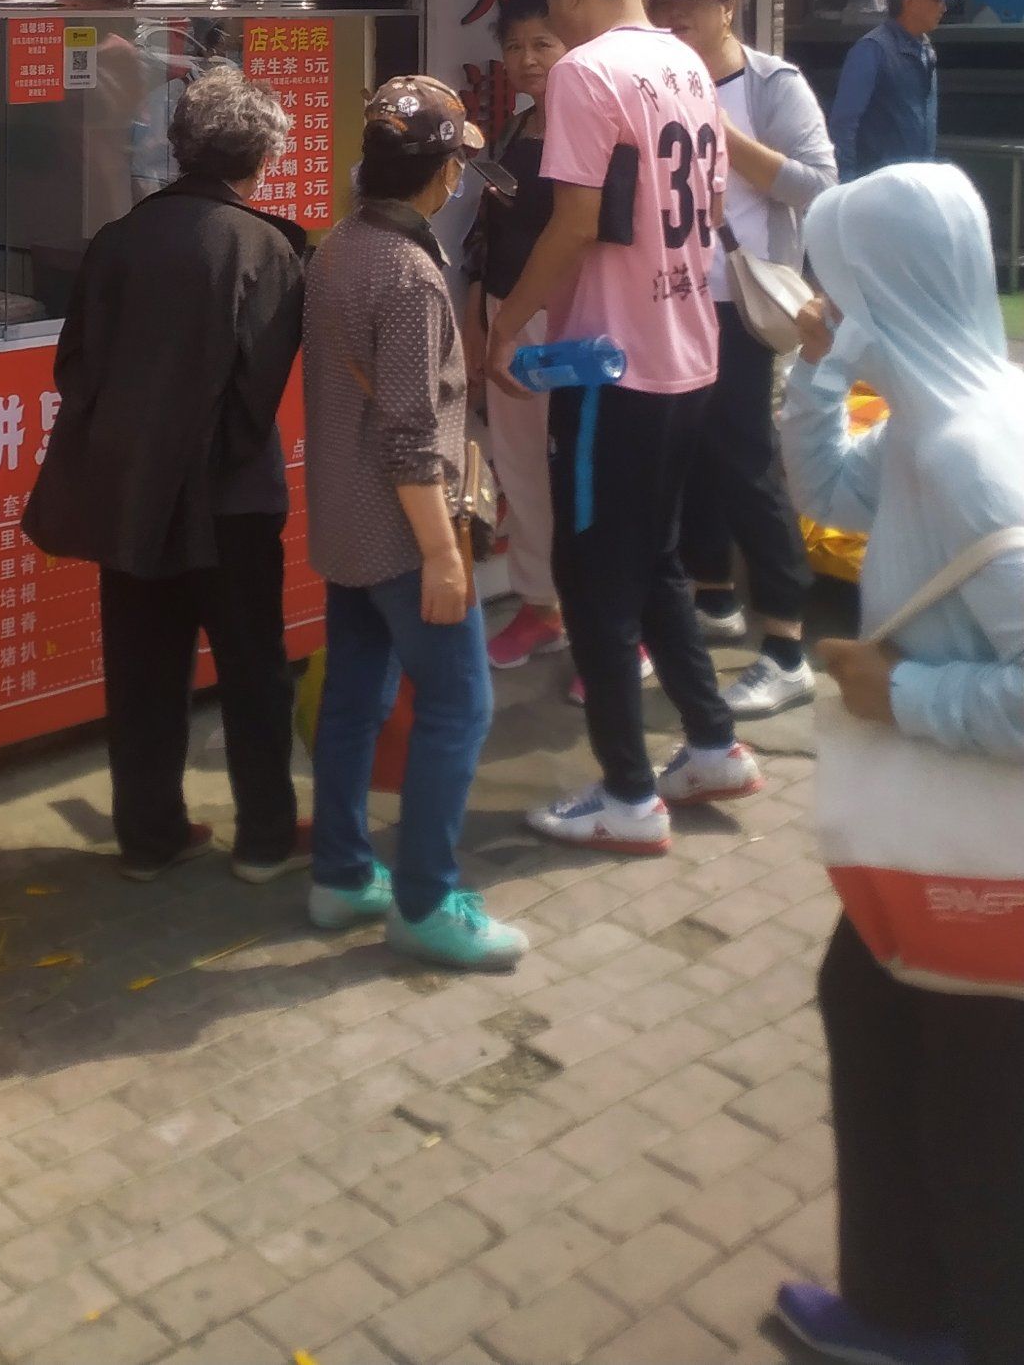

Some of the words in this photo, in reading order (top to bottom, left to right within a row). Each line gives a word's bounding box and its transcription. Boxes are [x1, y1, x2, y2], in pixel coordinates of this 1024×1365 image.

[249, 26, 330, 52] 店长推荐
[250, 56, 298, 76] 养生茶
[304, 57, 329, 74] 5元
[304, 91, 329, 108] 5元
[304, 113, 329, 130] 5元
[304, 134, 329, 152] 5元
[304, 156, 329, 173] 3元
[304, 179, 329, 196] 3元
[304, 202, 329, 219] 4元
